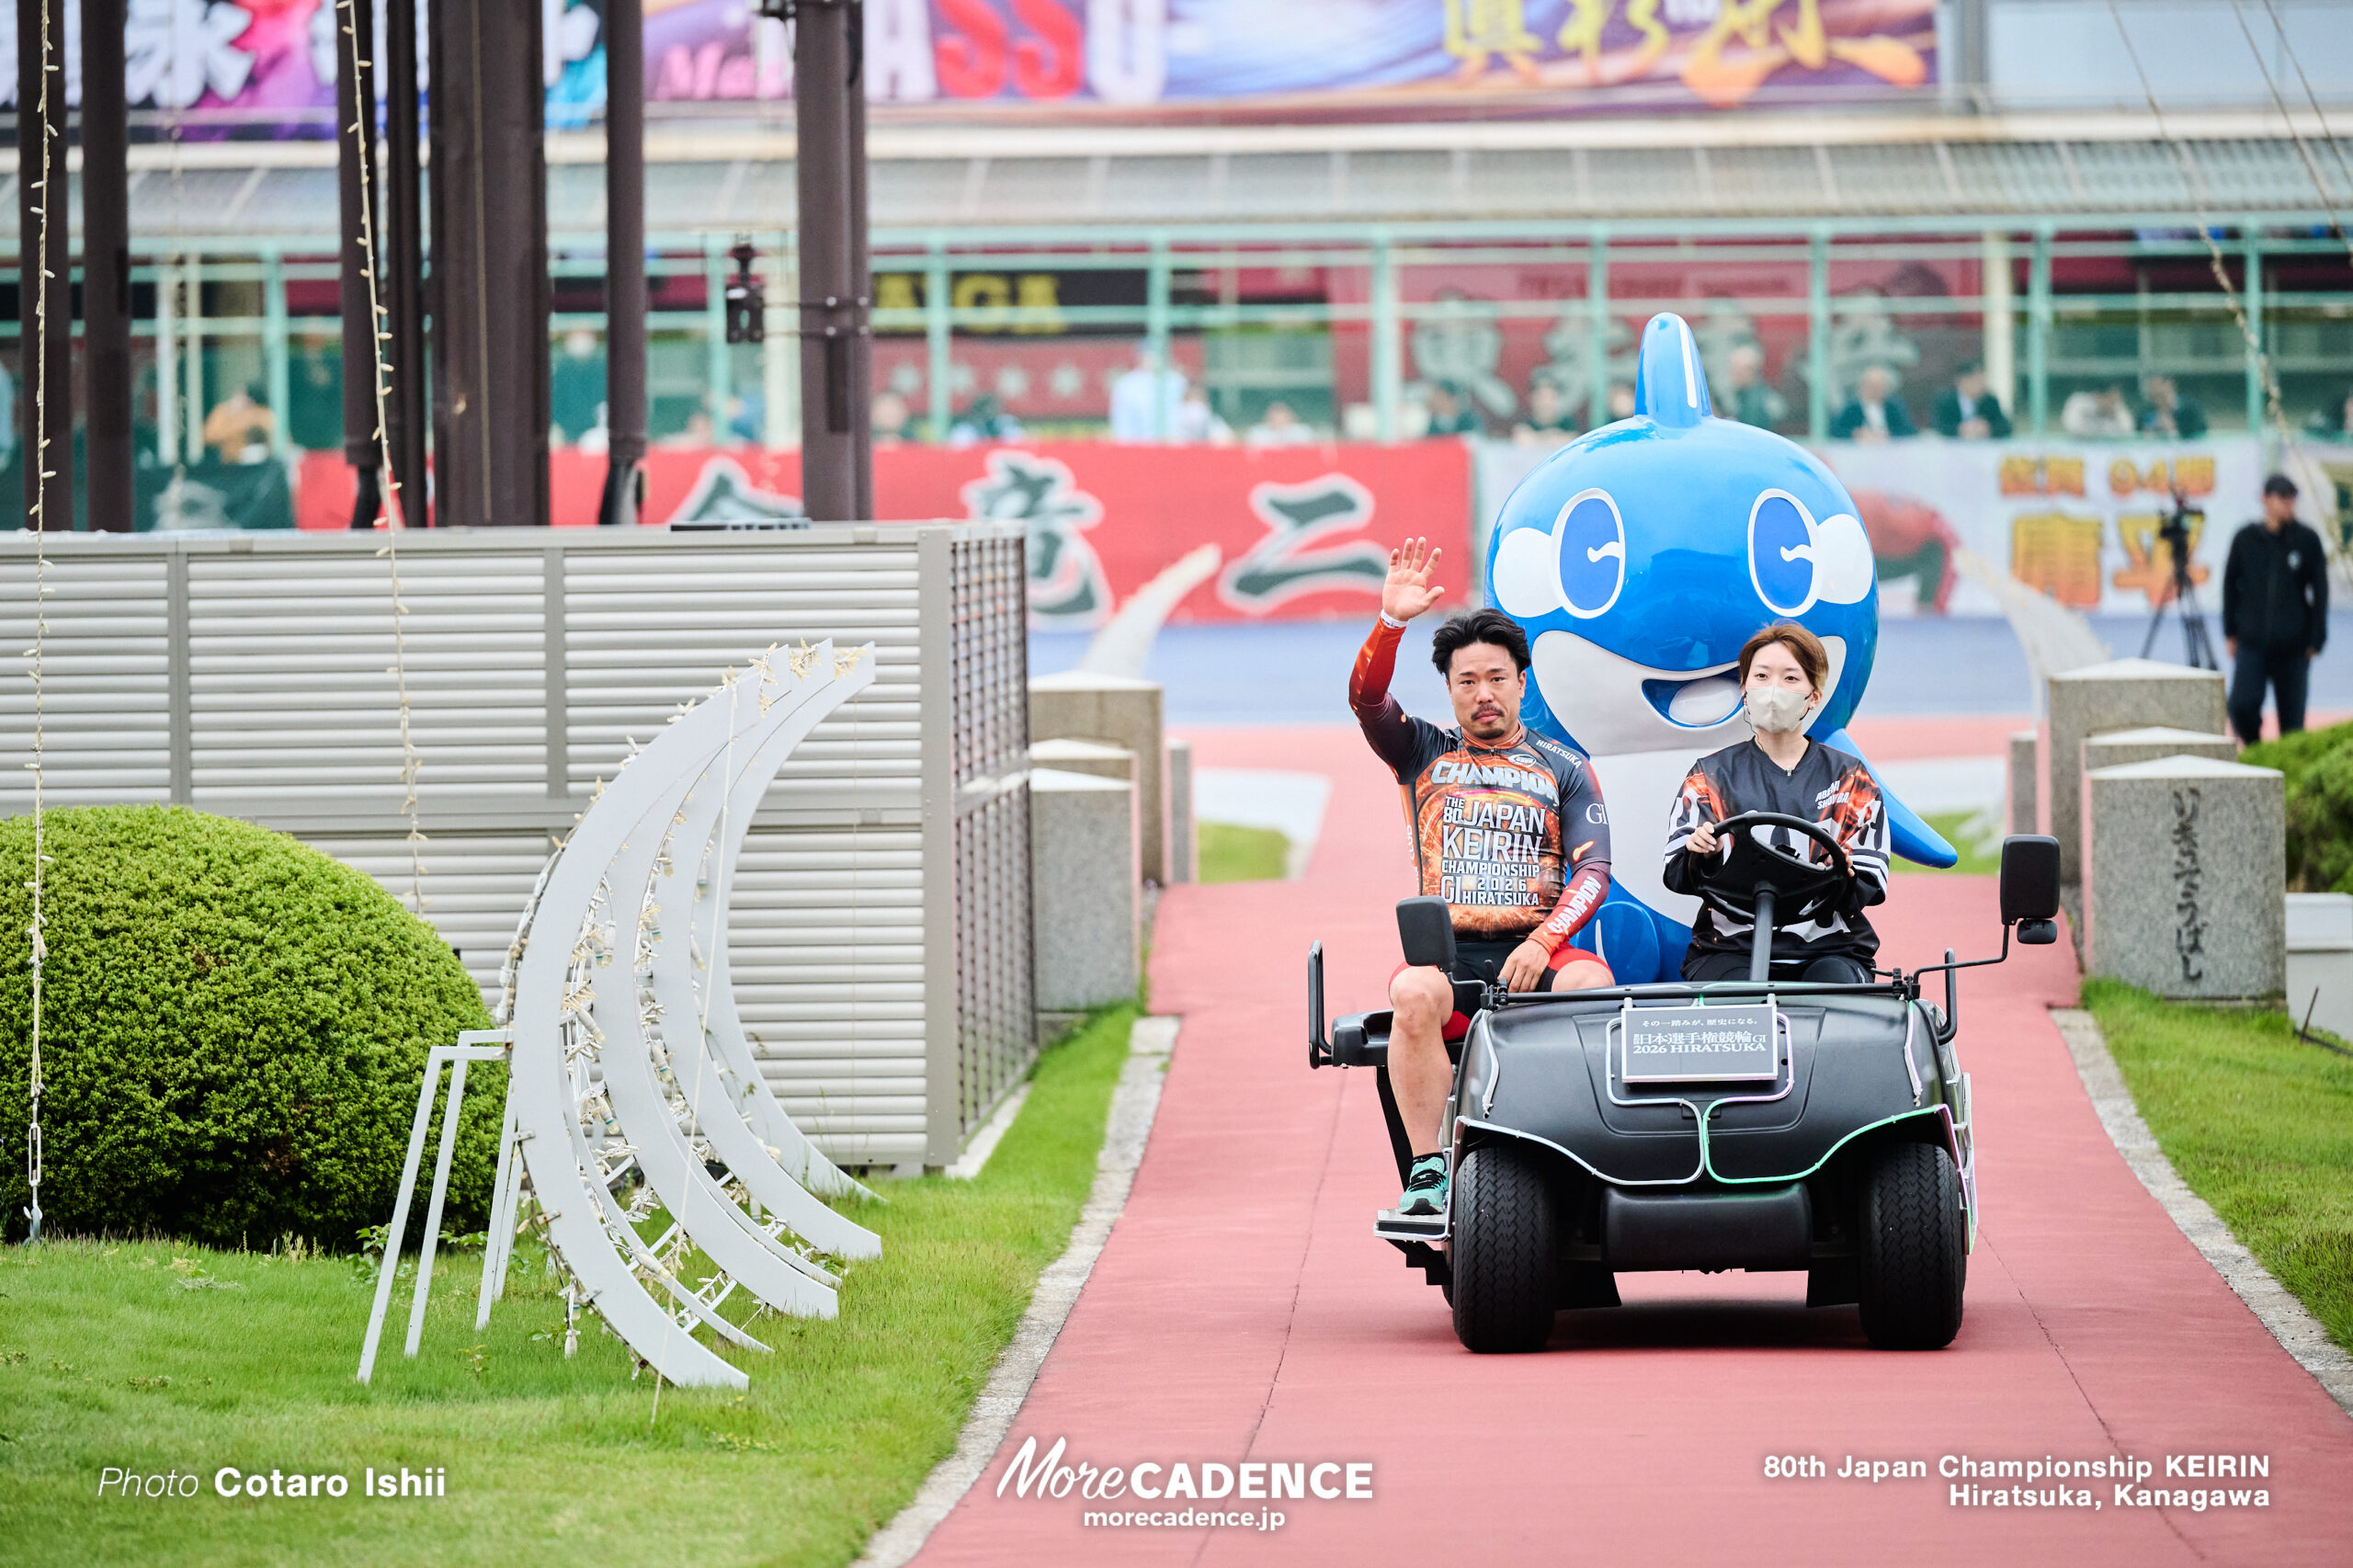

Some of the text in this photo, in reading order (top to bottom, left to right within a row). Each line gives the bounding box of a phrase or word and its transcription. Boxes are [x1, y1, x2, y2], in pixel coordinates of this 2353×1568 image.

[1535, 739, 1583, 769] HIRATSUKA
[1430, 760, 1560, 805] CHAMPION
[1445, 796, 1465, 809] THE
[1463, 801, 1546, 835] JAPAN
[1442, 824, 1543, 863] KEIRIN
[1441, 859, 1540, 877] CHAMPIONSHIP
[1477, 877, 1528, 892] 2026
[1462, 891, 1540, 906] HIRATSUKA
[1547, 875, 1602, 935] CHAMPION
[1632, 1042, 1767, 1054] 2026 HIRATSUKA
